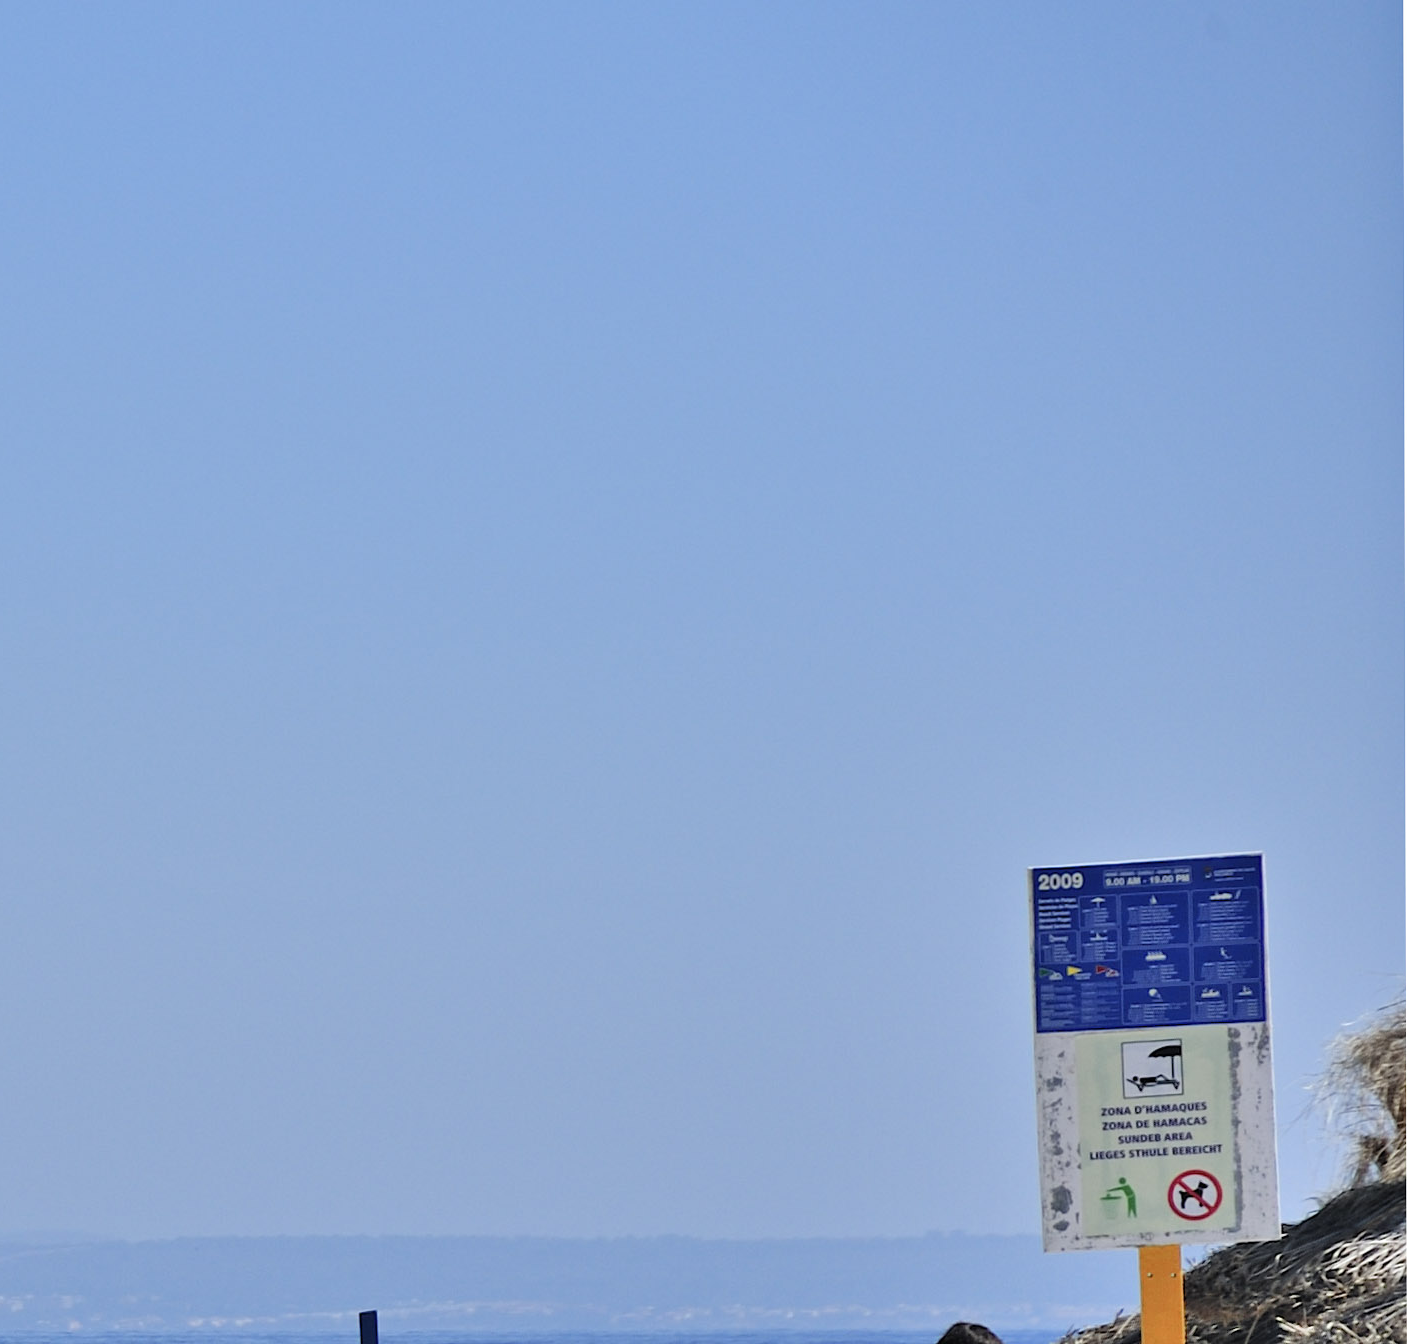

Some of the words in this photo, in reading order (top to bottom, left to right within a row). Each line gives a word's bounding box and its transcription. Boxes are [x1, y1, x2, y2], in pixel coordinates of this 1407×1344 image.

[1038, 873, 1083, 890] 2009
[1101, 1106, 1131, 1116] ZONA
[1134, 1102, 1207, 1114] D'HAMAQUES
[1102, 1120, 1132, 1131] ZONA
[1136, 1120, 1149, 1129] DE
[1153, 1116, 1208, 1128] HAMACAS
[1163, 1131, 1193, 1142] AREA
[1090, 1150, 1125, 1160] LIEGES
[1129, 1147, 1169, 1158] STHULE
[1172, 1144, 1222, 1155] BEREICHT
